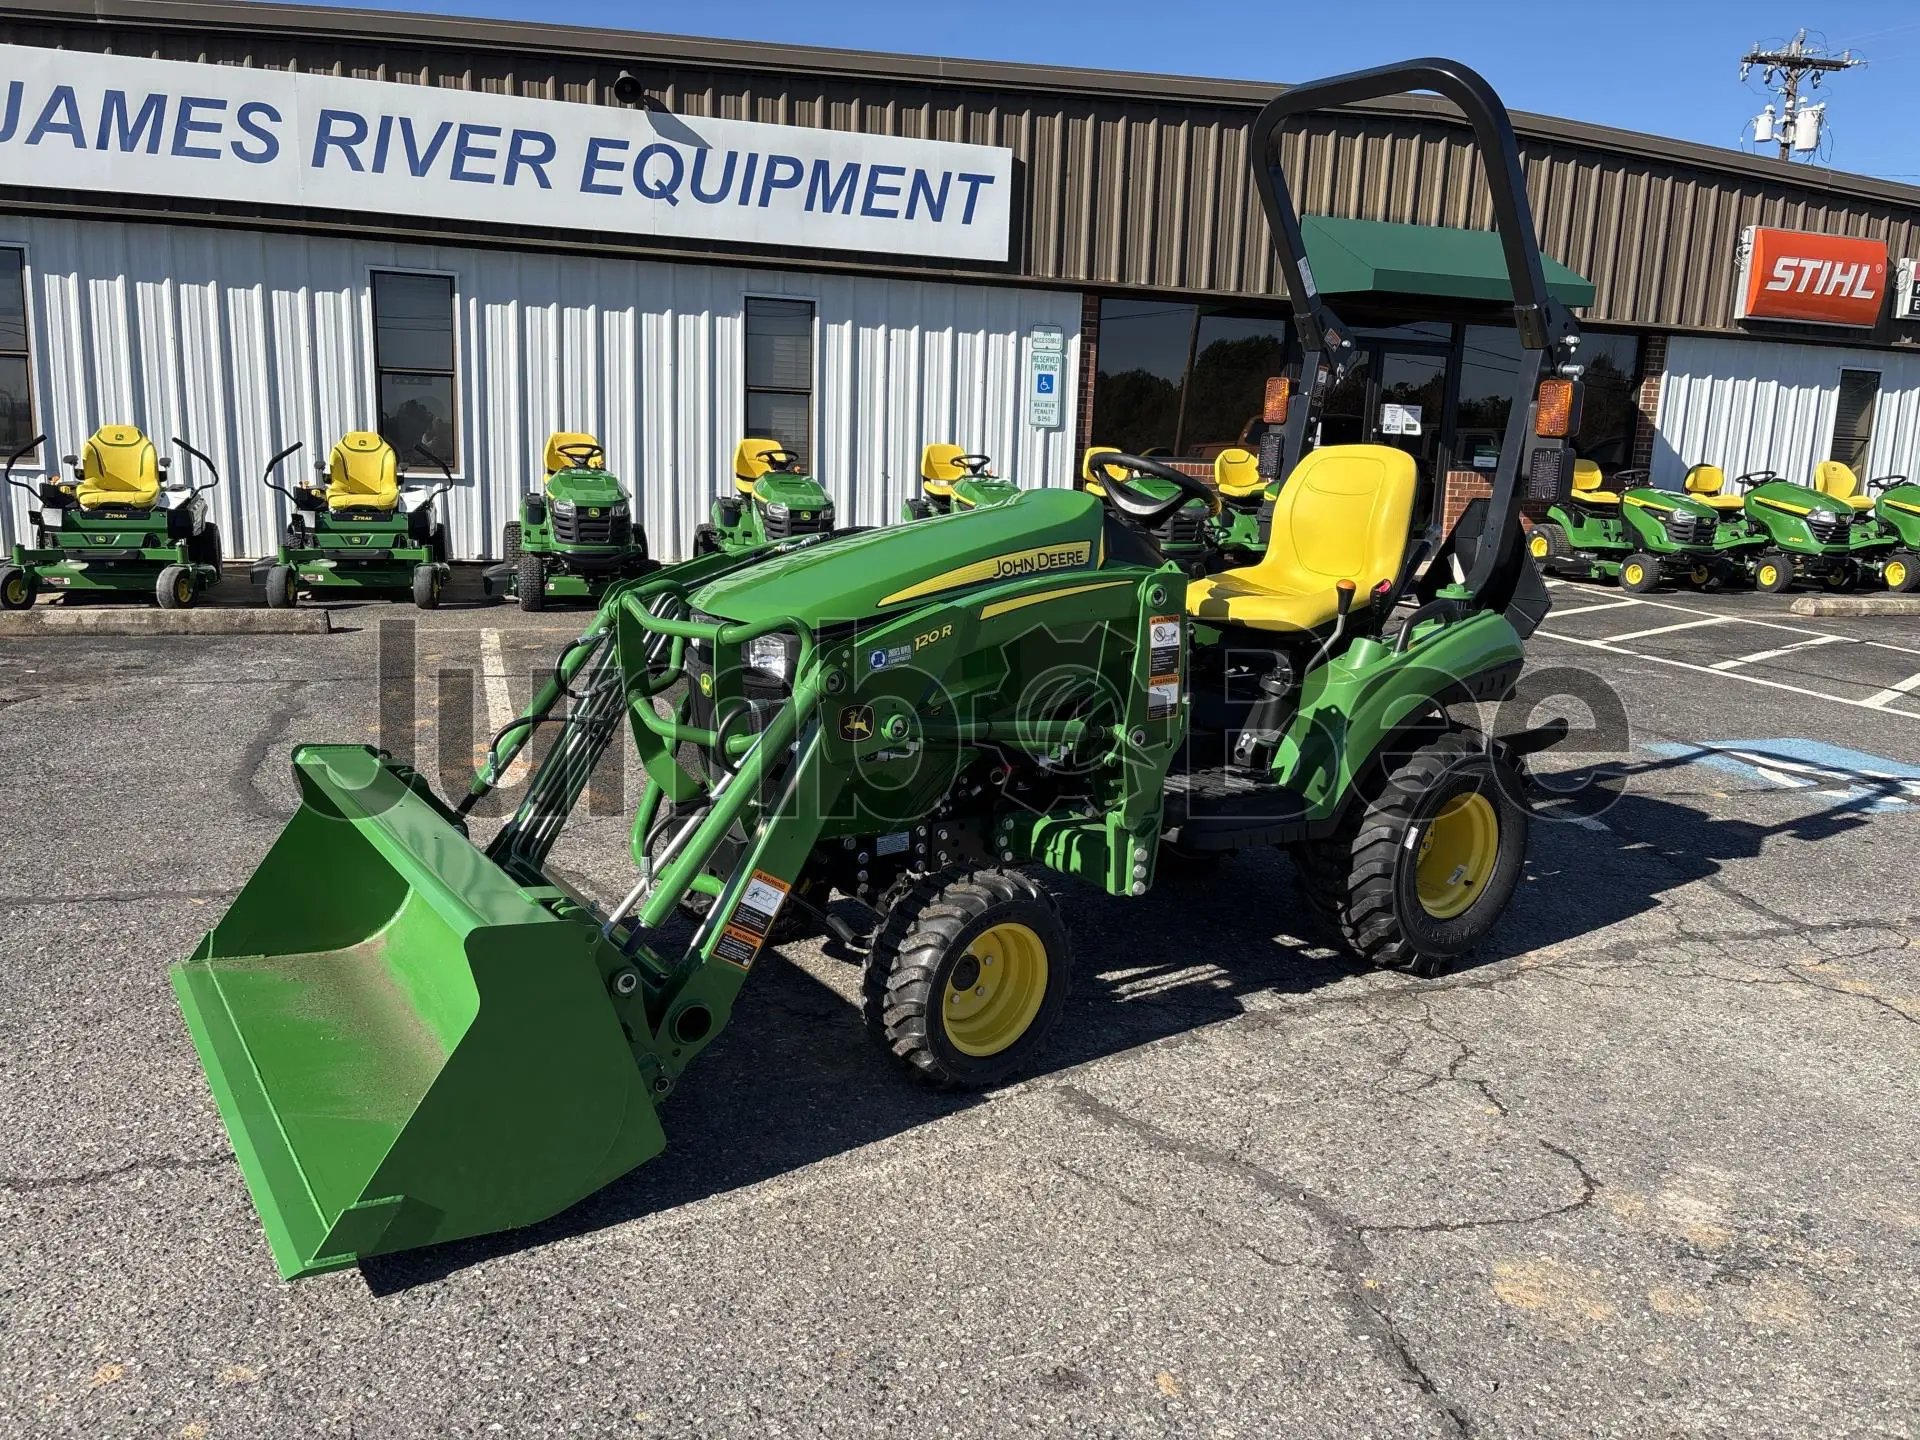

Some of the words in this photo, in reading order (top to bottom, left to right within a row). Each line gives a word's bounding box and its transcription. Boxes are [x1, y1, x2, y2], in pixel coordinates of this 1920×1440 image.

[0, 80, 283, 164] JAMES
[311, 108, 557, 189] RIVER
[580, 136, 995, 226] EQUIPMENT
[1764, 256, 1876, 300] STIHL
[1033, 355, 1060, 364] RESERVED
[1034, 364, 1058, 372] PARKING
[993, 558, 1035, 578] JOHN
[1037, 550, 1085, 570] DEERE
